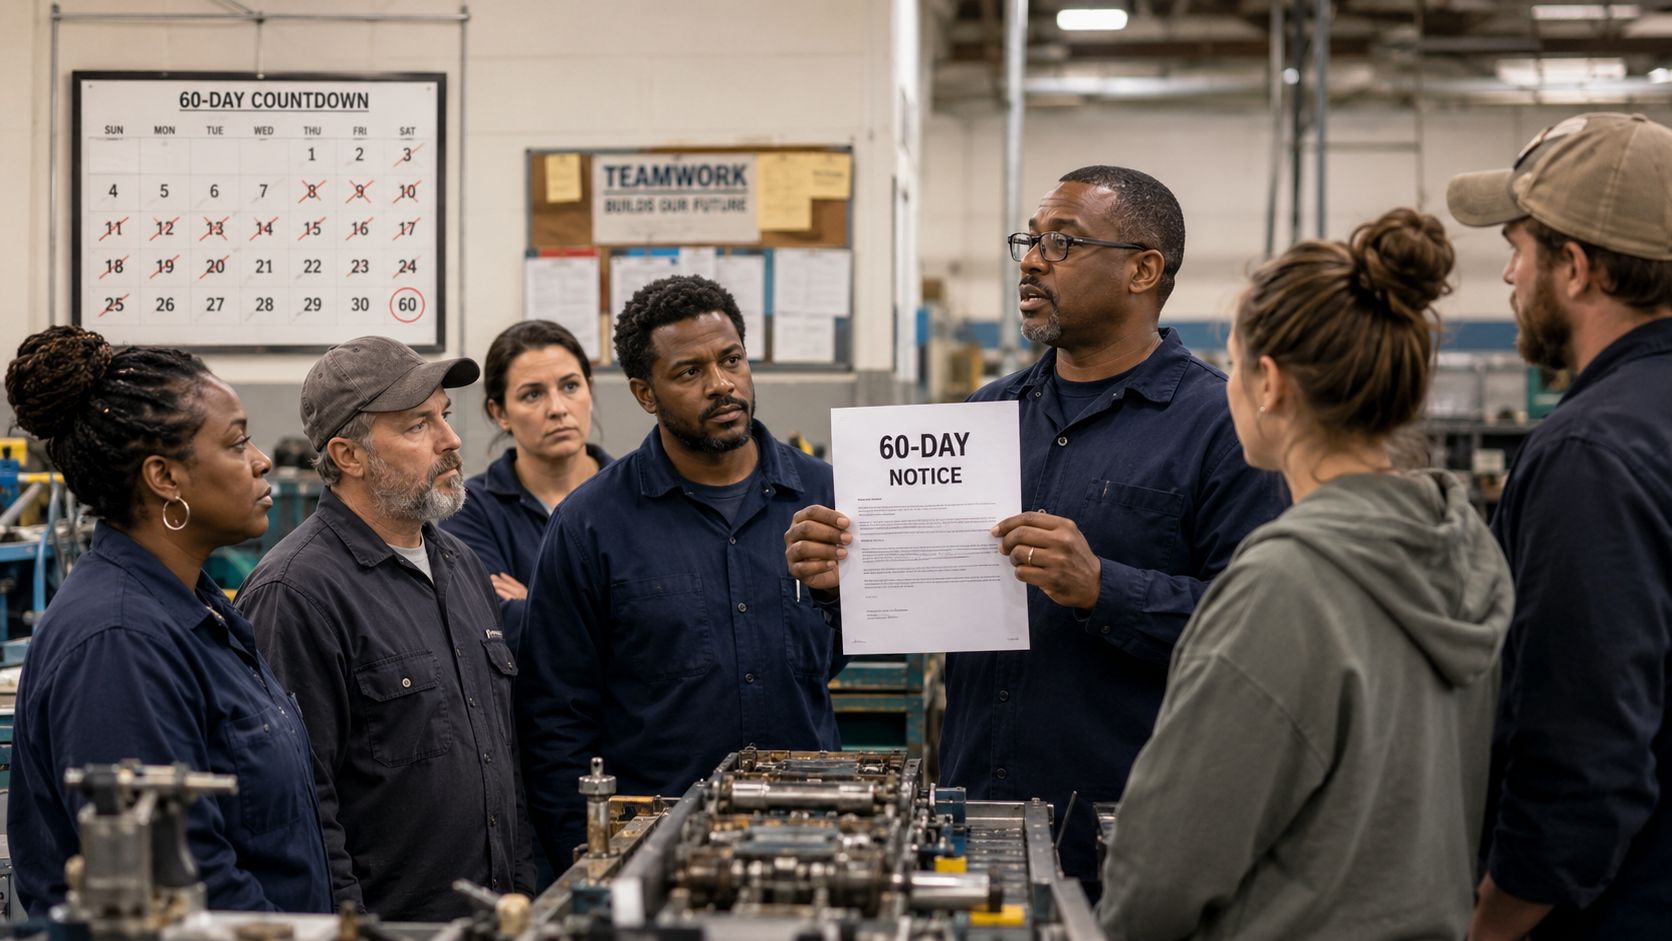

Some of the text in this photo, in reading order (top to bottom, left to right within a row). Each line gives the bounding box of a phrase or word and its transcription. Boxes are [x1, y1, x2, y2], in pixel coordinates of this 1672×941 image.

[179, 91, 369, 109] 60-DAY COUNTDOWN
[105, 125, 416, 135] SUN MON TUE WED THU FRI SAT
[309, 147, 315, 161] 1
[355, 147, 364, 161] 2
[604, 165, 747, 187] TEAMWORK
[108, 183, 118, 198] 4
[160, 183, 169, 198] 5
[210, 184, 219, 198] 6
[259, 184, 268, 198] 7
[400, 184, 416, 199] 10
[604, 198, 747, 213] BUILDS OUR FUTURE
[105, 221, 416, 236] 11 12 13 14 15 16 17
[105, 259, 417, 274] 18 19 20 21 22 23 24
[105, 297, 417, 312] 25 26 27 28 29 30 60
[879, 431, 970, 460] 60-DAY
[889, 466, 963, 487] NOTICE
